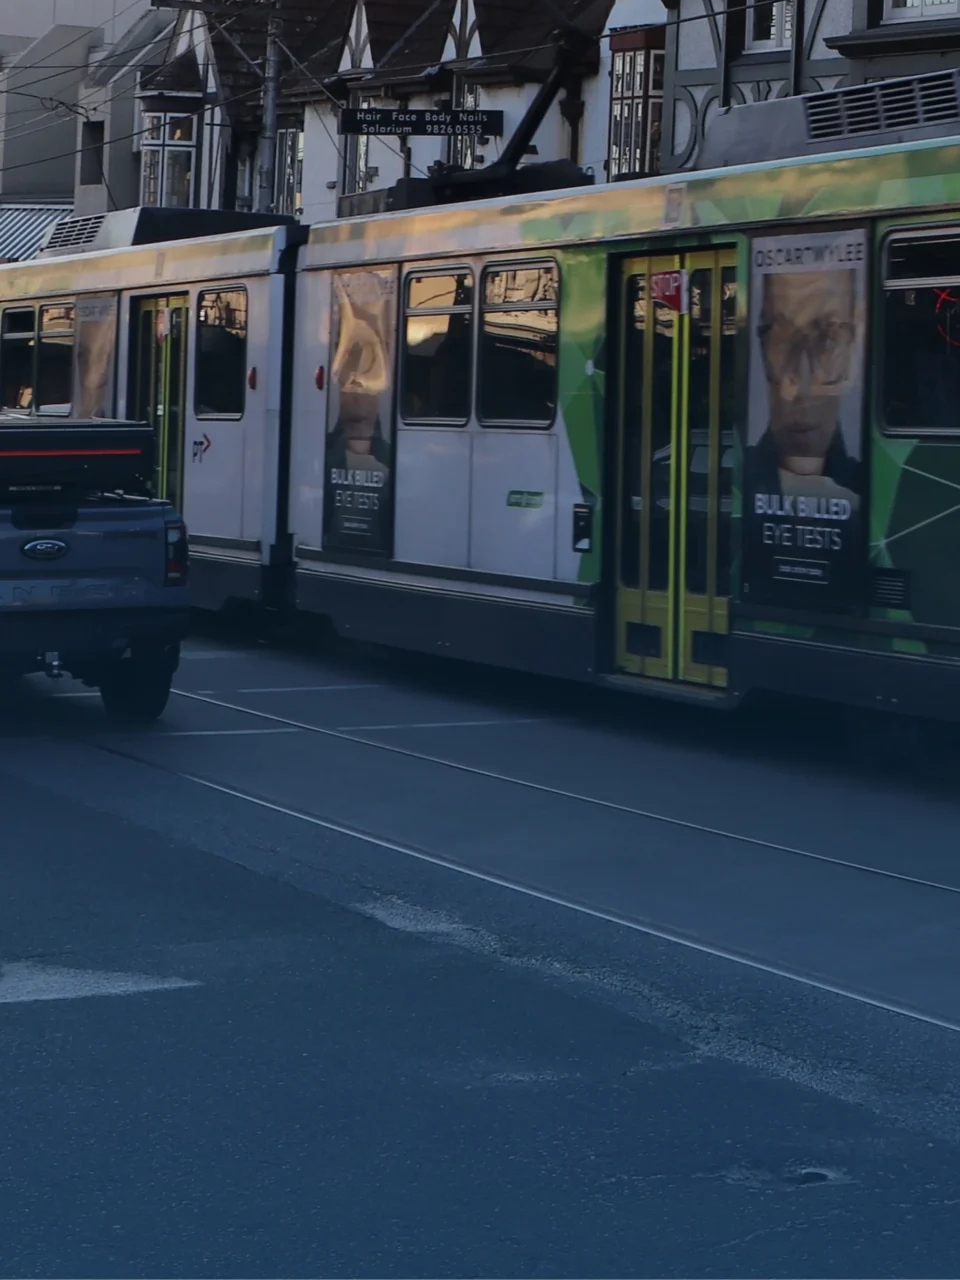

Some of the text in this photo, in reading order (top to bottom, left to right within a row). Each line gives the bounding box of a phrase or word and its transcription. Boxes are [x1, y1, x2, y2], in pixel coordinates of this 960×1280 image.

[357, 111, 488, 123] Hair Face Body Nails
[362, 123, 412, 133] Solarium
[754, 493, 851, 520] BULK BILLED
[763, 523, 842, 550] EYE TESTS
